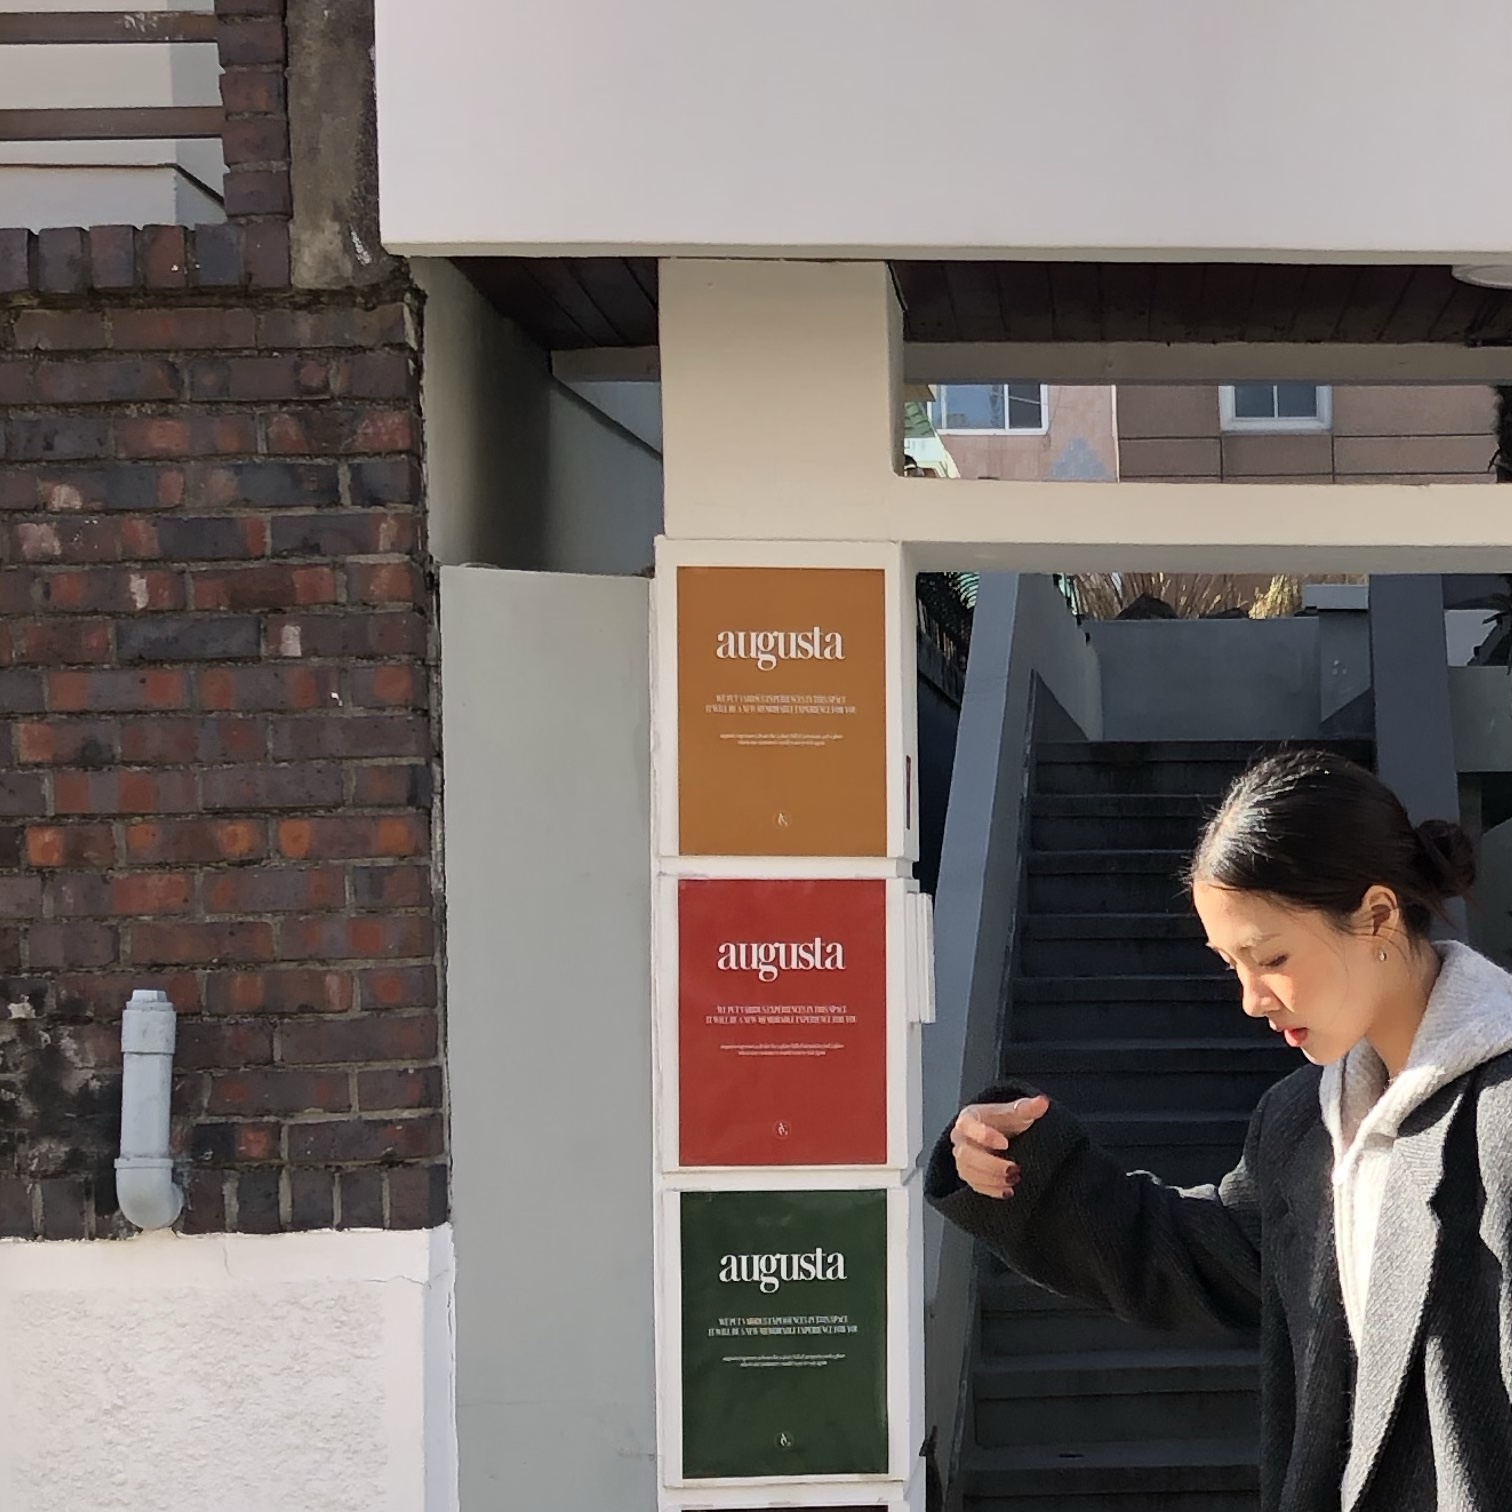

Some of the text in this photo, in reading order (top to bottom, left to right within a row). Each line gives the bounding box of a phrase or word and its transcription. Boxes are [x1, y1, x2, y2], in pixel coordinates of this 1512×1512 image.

[716, 626, 846, 671] augusta
[717, 937, 846, 982] augusta
[719, 1247, 848, 1293] augusta
